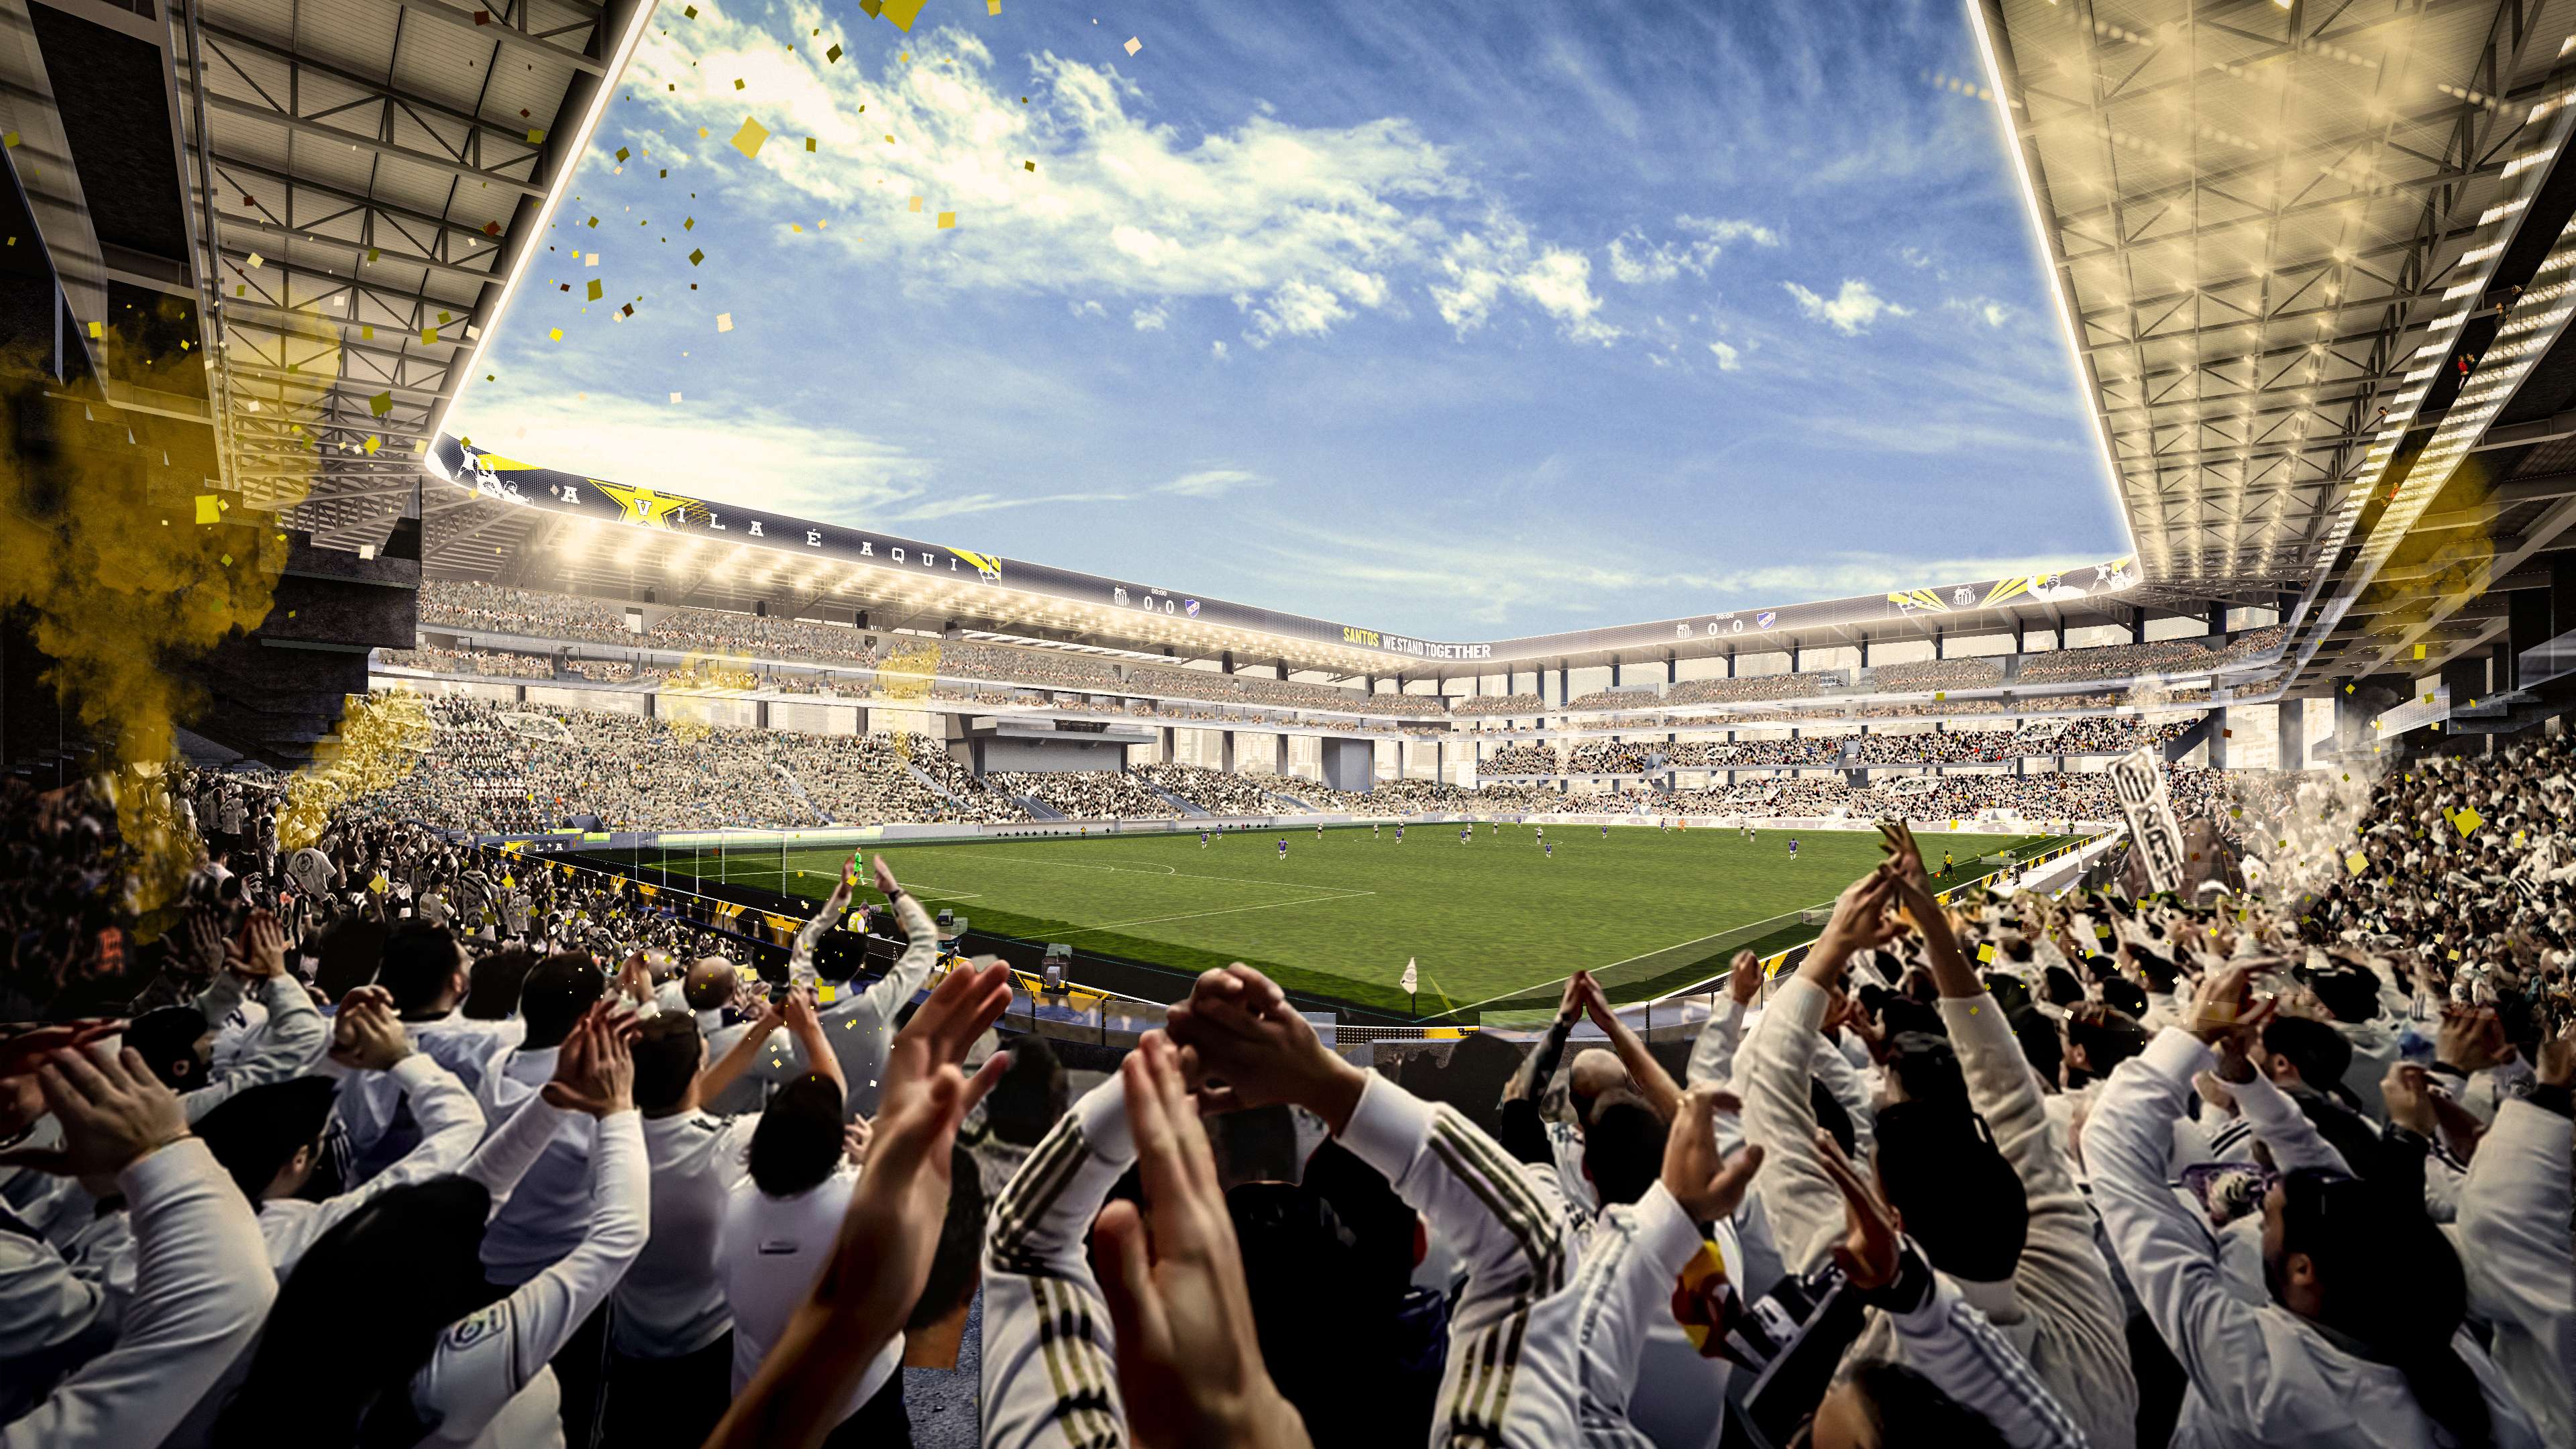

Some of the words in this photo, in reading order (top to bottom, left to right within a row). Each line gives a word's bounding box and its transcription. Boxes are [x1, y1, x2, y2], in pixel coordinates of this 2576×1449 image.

[861, 541, 957, 571] AQUI
[1151, 588, 1167, 596] 00:00
[1144, 596, 1153, 610] 0
[1165, 600, 1174, 614] 0
[1708, 623, 1718, 635] 0
[1733, 620, 1743, 633] 0
[1343, 627, 1379, 647] SANTOS
[1383, 635, 1397, 650] WE
[1397, 638, 1423, 655] STAND
[1425, 643, 1491, 659] TOGETHER
